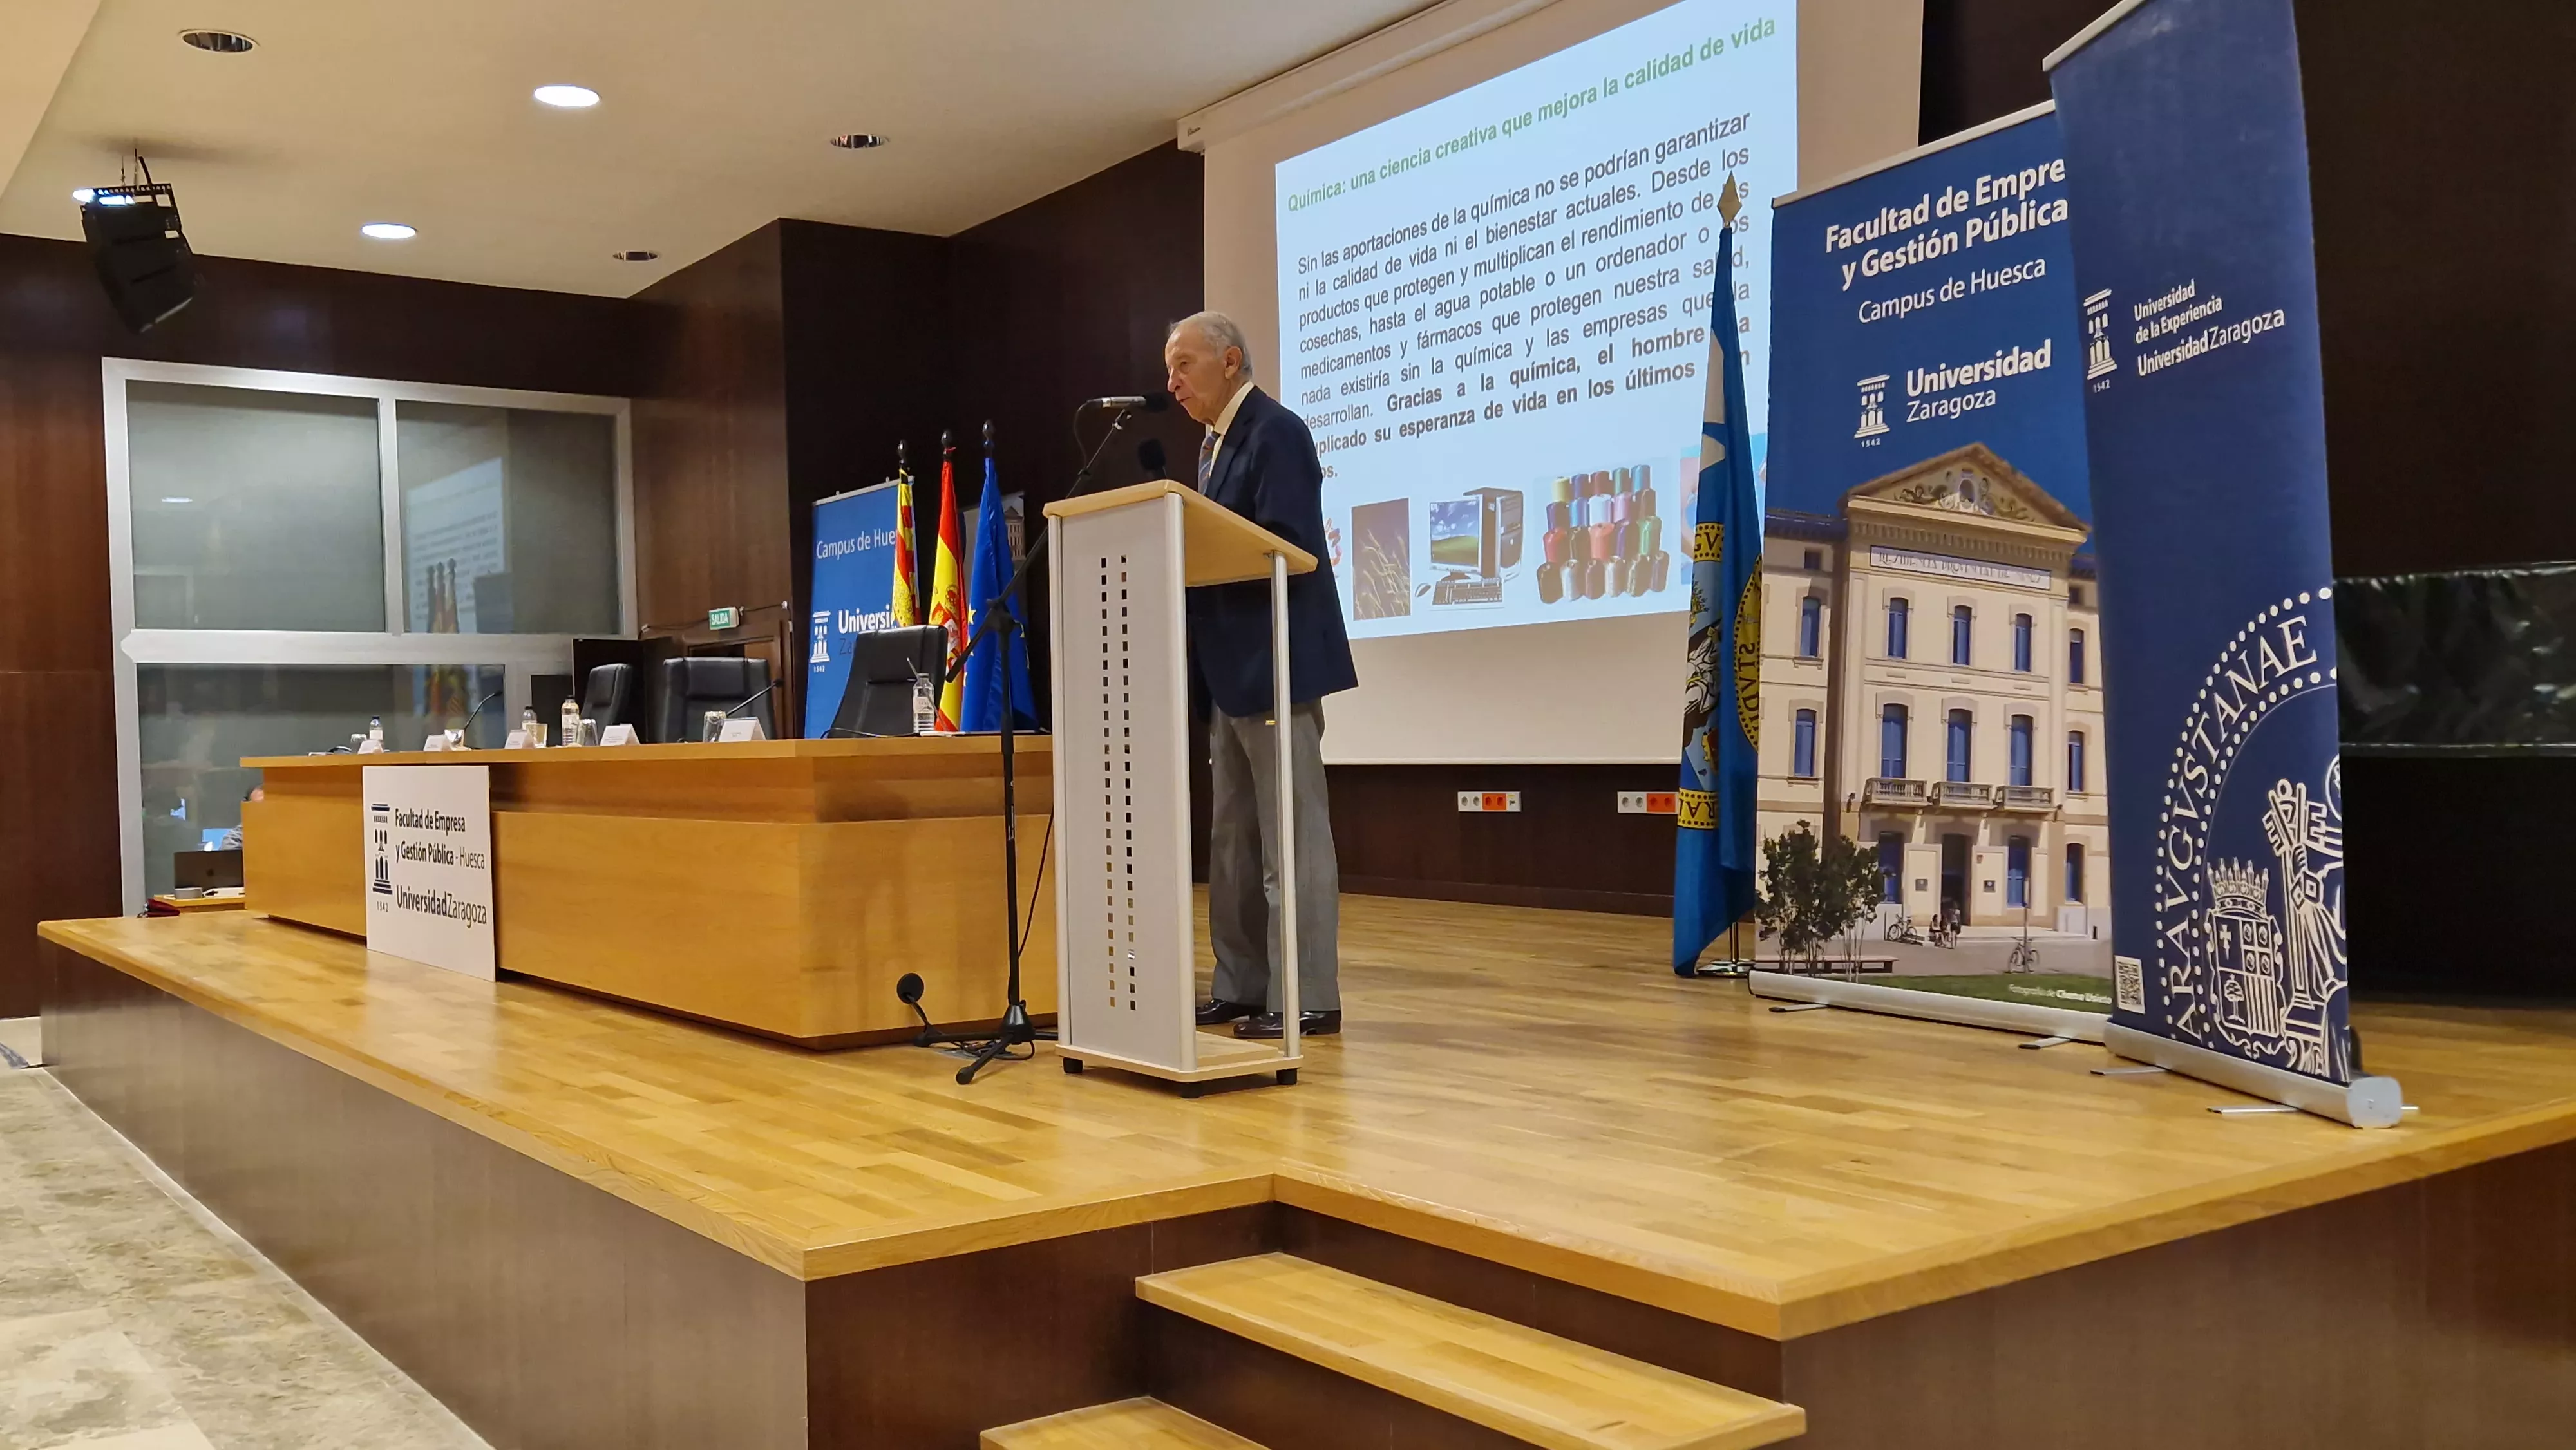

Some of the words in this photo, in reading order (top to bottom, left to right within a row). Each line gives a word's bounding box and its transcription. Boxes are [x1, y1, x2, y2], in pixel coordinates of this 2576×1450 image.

[1288, 180, 1346, 212] Química:
[1350, 169, 1376, 191] una
[1379, 147, 1431, 180] ciencia
[1435, 124, 1497, 160] creativa
[1501, 111, 1533, 138] que
[1537, 86, 1597, 122] mejora
[1603, 77, 1619, 99] la
[1624, 44, 1694, 89] calidad
[1700, 37, 1725, 61] de
[1730, 18, 1775, 49] vida
[1298, 255, 1318, 275] Sin
[1321, 250, 1339, 268] las
[1343, 221, 1428, 263] aportaciones
[1431, 212, 1450, 233] de
[1454, 206, 1466, 226] la
[1470, 187, 1530, 223] química
[1535, 179, 1555, 200] no
[1560, 171, 1579, 191] se
[1584, 147, 1649, 189] podrían
[1654, 112, 1750, 165] garantizar
[1298, 281, 1309, 301] ni
[1316, 278, 1327, 297] la
[1332, 260, 1378, 291] calidad
[1385, 255, 1402, 276] de
[1408, 244, 1437, 268] vida
[1444, 235, 1457, 258] ni
[1465, 229, 1478, 251] el
[1486, 208, 1558, 245] bienestar
[1566, 184, 1641, 220] actuales.
[1651, 157, 1711, 193] Desde
[1721, 147, 1749, 171] los
[1826, 193, 1930, 254] Facultad
[1935, 185, 1969, 218] de
[1976, 158, 2066, 207] Empre
[1299, 298, 1360, 329] productos
[1364, 290, 1389, 312] que
[1394, 270, 1455, 306] protegen
[1459, 265, 1469, 287] y
[1473, 240, 1555, 278] multiplican
[1560, 229, 1575, 252] el
[1582, 200, 1683, 247] rendimiento
[1691, 190, 1714, 214] de
[1842, 260, 1857, 292] y
[1861, 229, 1958, 277] Gestión
[1965, 198, 2069, 249] Pública
[1300, 325, 1361, 353] cosechas,
[1369, 310, 1406, 335] hasta
[1414, 301, 1426, 323] el
[1435, 294, 1470, 320] agua
[1479, 274, 1535, 310] potable
[1545, 270, 1555, 287] o
[1566, 261, 1586, 281] un
[1595, 232, 1687, 273] ordenador
[1698, 227, 1710, 244] o
[1859, 288, 1935, 323] Campus
[1939, 276, 1966, 303] de
[1969, 258, 2046, 294] Huesca
[2134, 278, 2195, 321] Universidad
[2135, 325, 2149, 344] de
[2150, 321, 2159, 339] la
[2160, 294, 2223, 334] Experiencia
[1300, 344, 1392, 380] medicamentos
[1399, 339, 1408, 360] y
[1416, 320, 1482, 351] fármacos
[1492, 310, 1520, 335] que
[1531, 288, 1602, 326] protegen
[1614, 268, 1680, 300] nuestra
[1302, 383, 1331, 406] nada
[1341, 369, 1390, 397] existiría
[1401, 362, 1421, 382] sin
[1431, 356, 1444, 375] la
[1455, 341, 1513, 373] química
[1524, 336, 1534, 359] y
[1546, 327, 1569, 348] las
[1582, 303, 1668, 339] empresas
[1387, 386, 1443, 413] Gracias
[1456, 382, 1466, 397] a
[1481, 372, 1495, 393] la
[1509, 356, 1580, 390] química,
[1598, 343, 1613, 366] el
[1631, 327, 1705, 359] hombre
[1906, 337, 2052, 397] Universidad
[1374, 426, 1391, 443] su
[1399, 409, 1475, 439] esperanza
[1484, 400, 1504, 420] de
[1511, 390, 1548, 415] vida
[1557, 386, 1578, 406] en
[1588, 379, 1615, 399] los
[1625, 362, 1695, 391] últimos
[1906, 389, 1996, 422] Zaragoza
[1861, 438, 1881, 448] 1542
[816, 537, 856, 561] Campus
[857, 530, 871, 551] de
[873, 527, 896, 549] Hue
[711, 612, 729, 626] SALIDA
[838, 603, 893, 634] Universi
[395, 808, 423, 829] Facultad
[424, 809, 433, 830] de
[435, 810, 466, 836] Empresa
[395, 843, 401, 863] y
[401, 840, 427, 862] Gestión
[428, 842, 454, 865] Pública
[459, 845, 485, 869] Huesca
[377, 901, 388, 912] 1542
